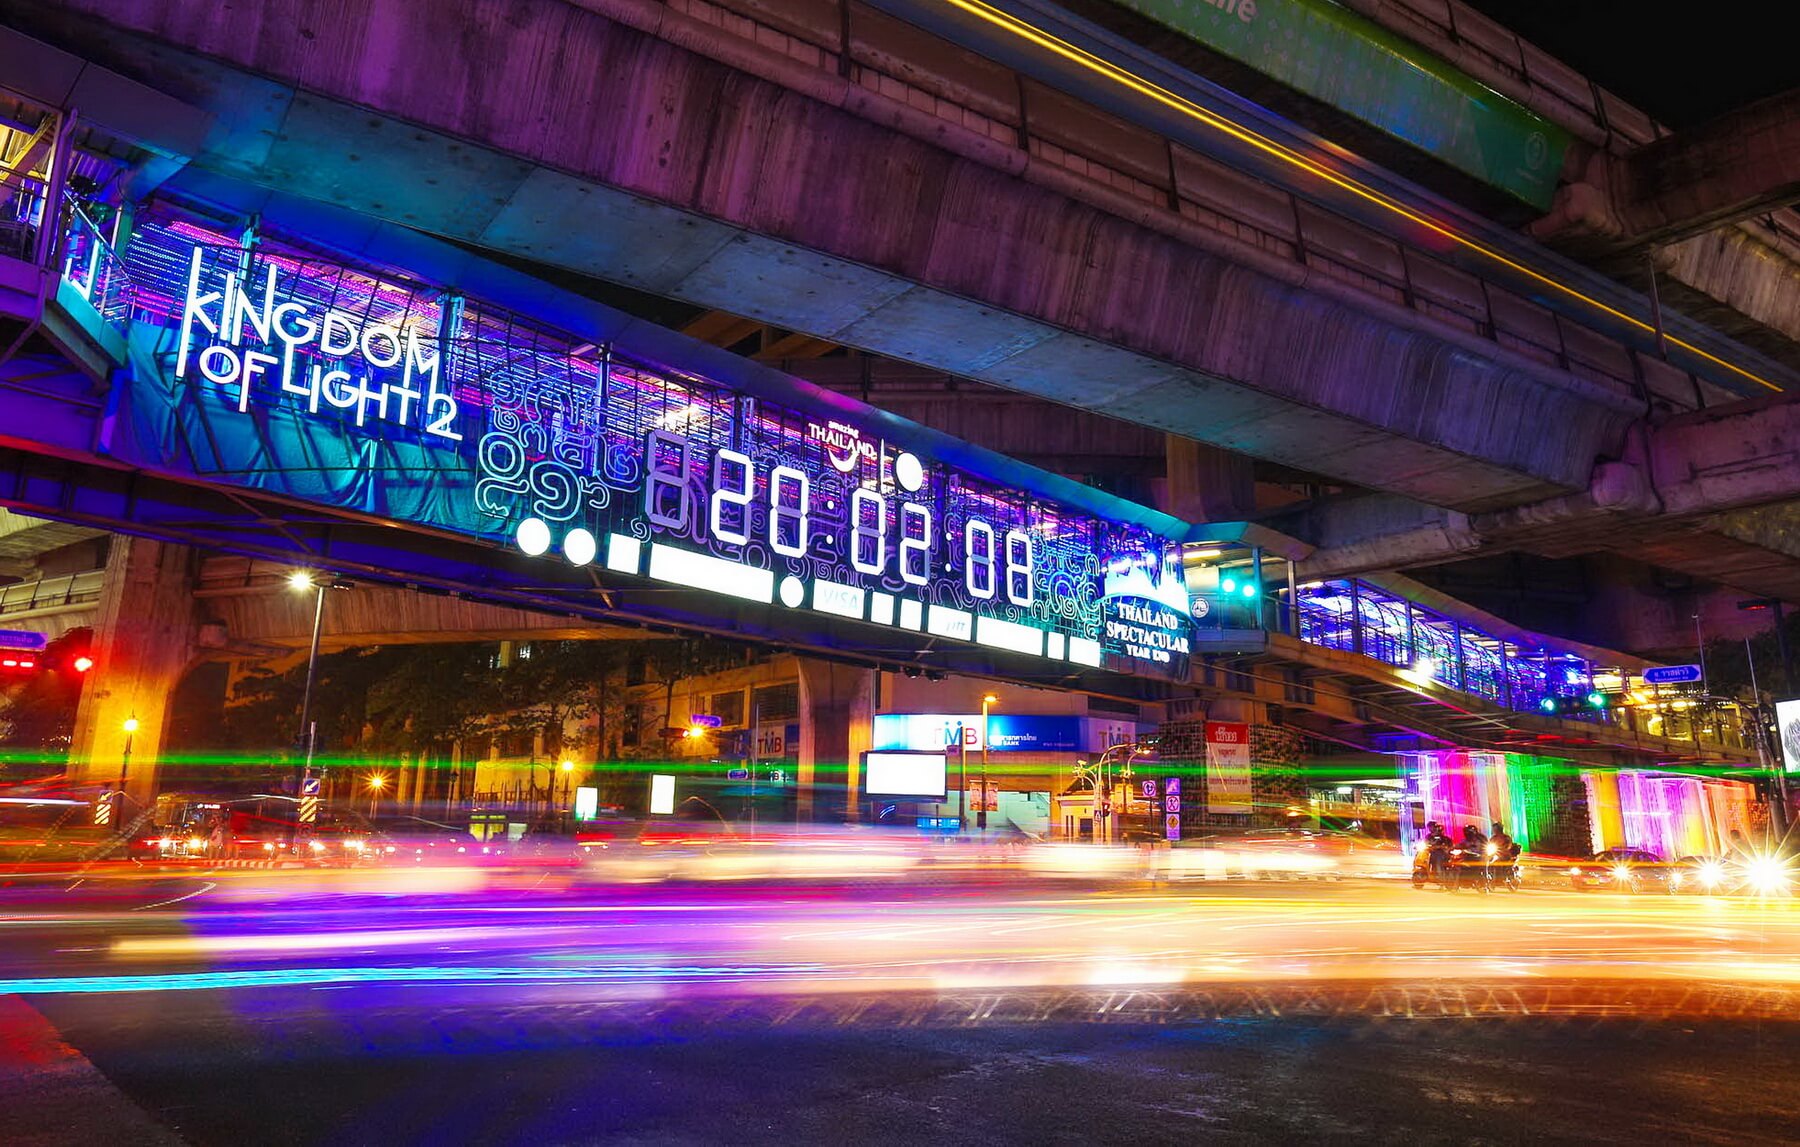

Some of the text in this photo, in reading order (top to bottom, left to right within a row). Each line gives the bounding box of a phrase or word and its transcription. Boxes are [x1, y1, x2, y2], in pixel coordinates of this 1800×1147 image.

[177, 246, 442, 414] KINGDOM
[199, 338, 463, 440] OF LIGHT 2
[808, 422, 874, 457] THAILAND
[1117, 603, 1178, 630] THAILAND
[1107, 621, 1189, 654] SPECTACULAR
[1125, 644, 1171, 663] YEAR END
[757, 736, 783, 755] TMB
[934, 725, 978, 746] TMB
